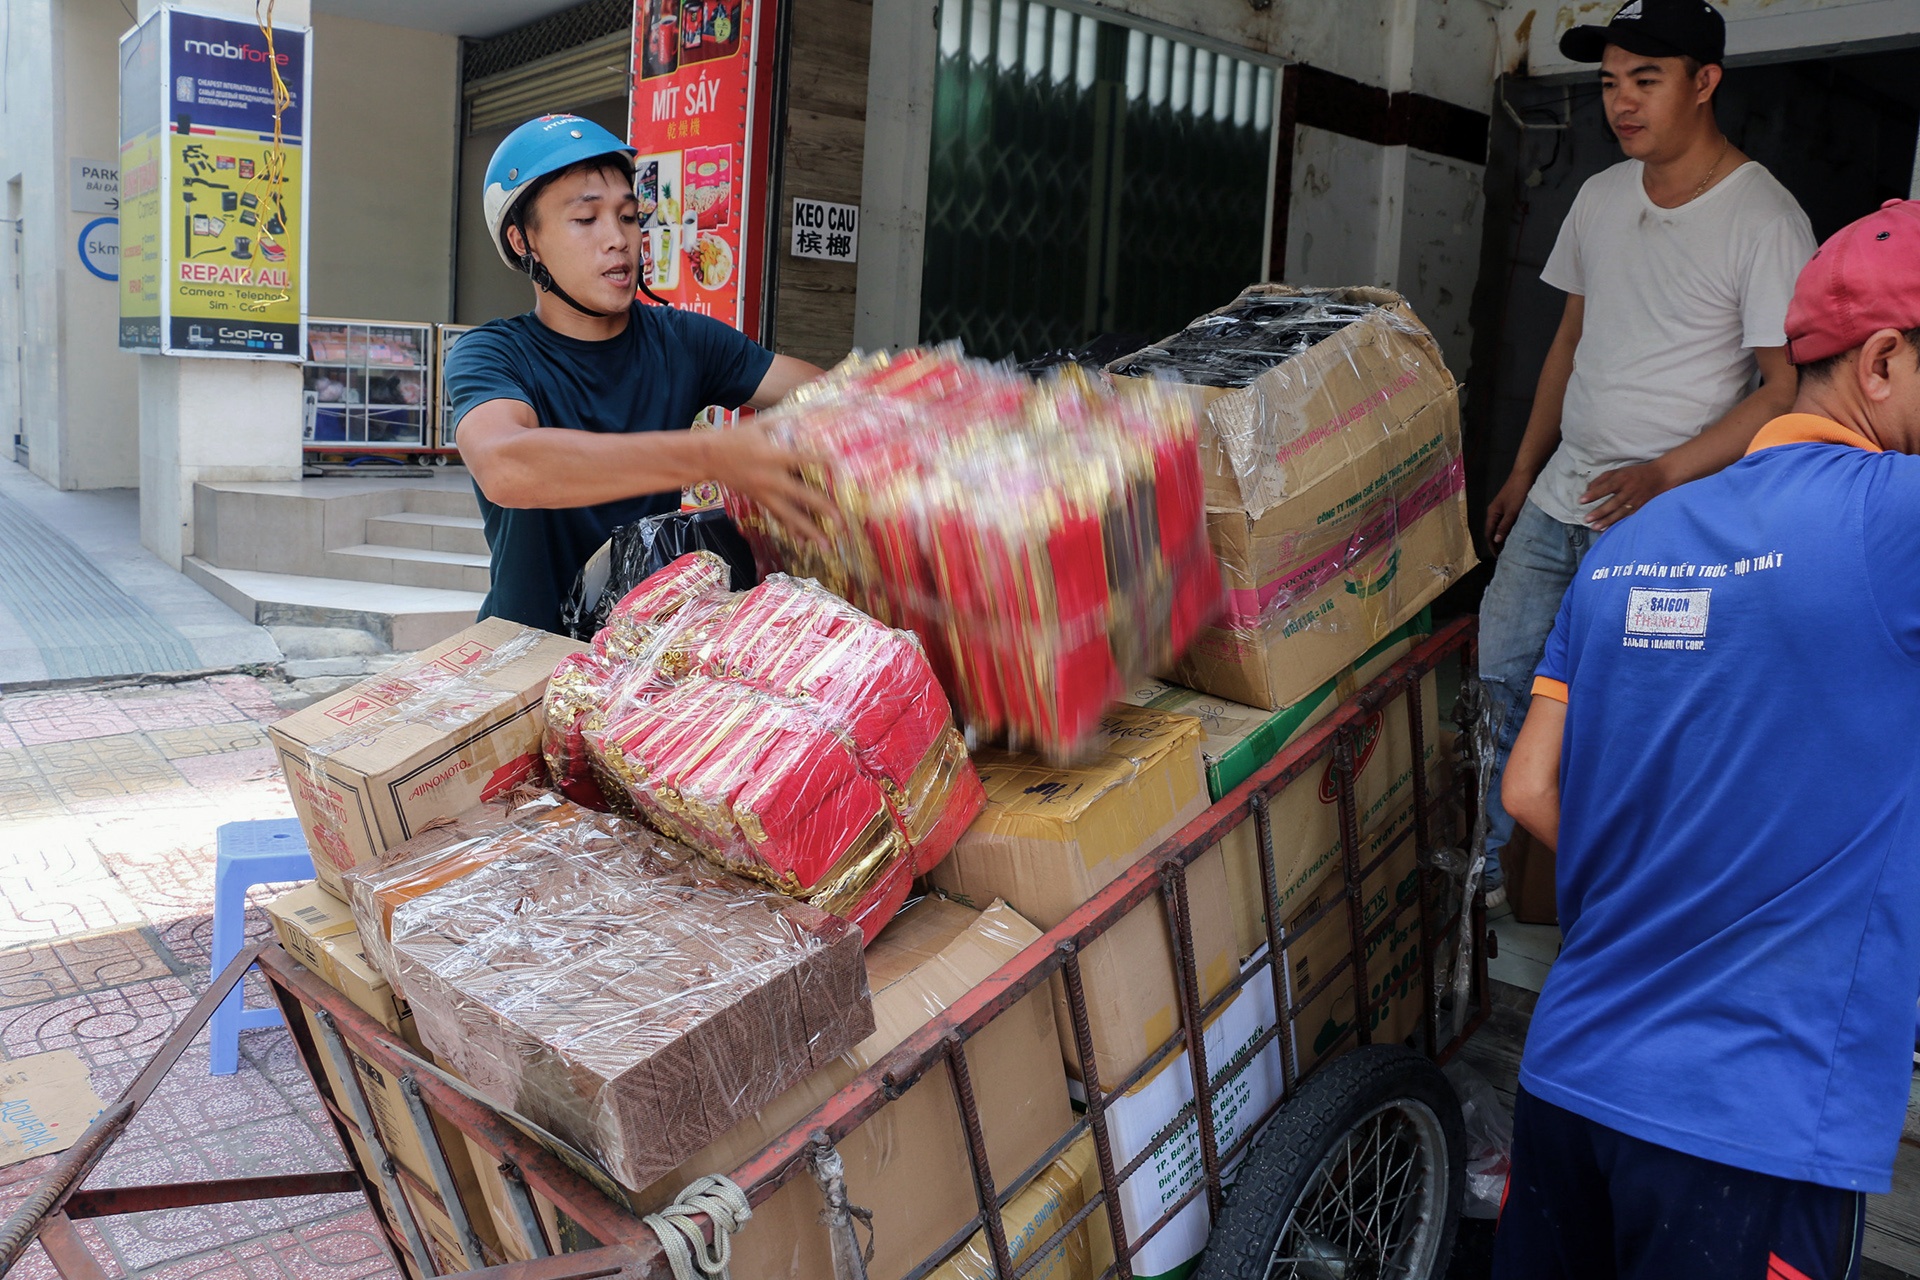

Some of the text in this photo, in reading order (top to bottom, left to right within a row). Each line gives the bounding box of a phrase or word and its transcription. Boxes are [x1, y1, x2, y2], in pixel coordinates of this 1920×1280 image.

[184, 39, 290, 66] mobifone
[652, 69, 720, 122] MÍT SẤY
[796, 203, 855, 232] KEO CAU
[181, 264, 290, 287] REPAIR ALL
[180, 286, 225, 298] Camera
[209, 301, 229, 310] Sim
[218, 327, 284, 341] GoPro
[1316, 508, 1336, 525] CÔNG
[1336, 501, 1346, 515] TY
[1278, 559, 1327, 591] COCONUT
[1650, 597, 1690, 613] SAIGON
[409, 759, 468, 801] AJINOMOTO
[1248, 1025, 1264, 1049] TIẾN
[0, 1099, 58, 1153] AQUAFINA
[1155, 1158, 1169, 1174] TP.
[1170, 1144, 1187, 1161] Bến
[1220, 1094, 1235, 1113] Bến
[1234, 1080, 1248, 1095] Tre.
[1158, 1170, 1177, 1189] Điện
[1223, 1106, 1239, 1124] 829
[1238, 1089, 1251, 1109] 707
[1161, 1184, 1178, 1204] Fax:
[1219, 1126, 1235, 1145] 920
